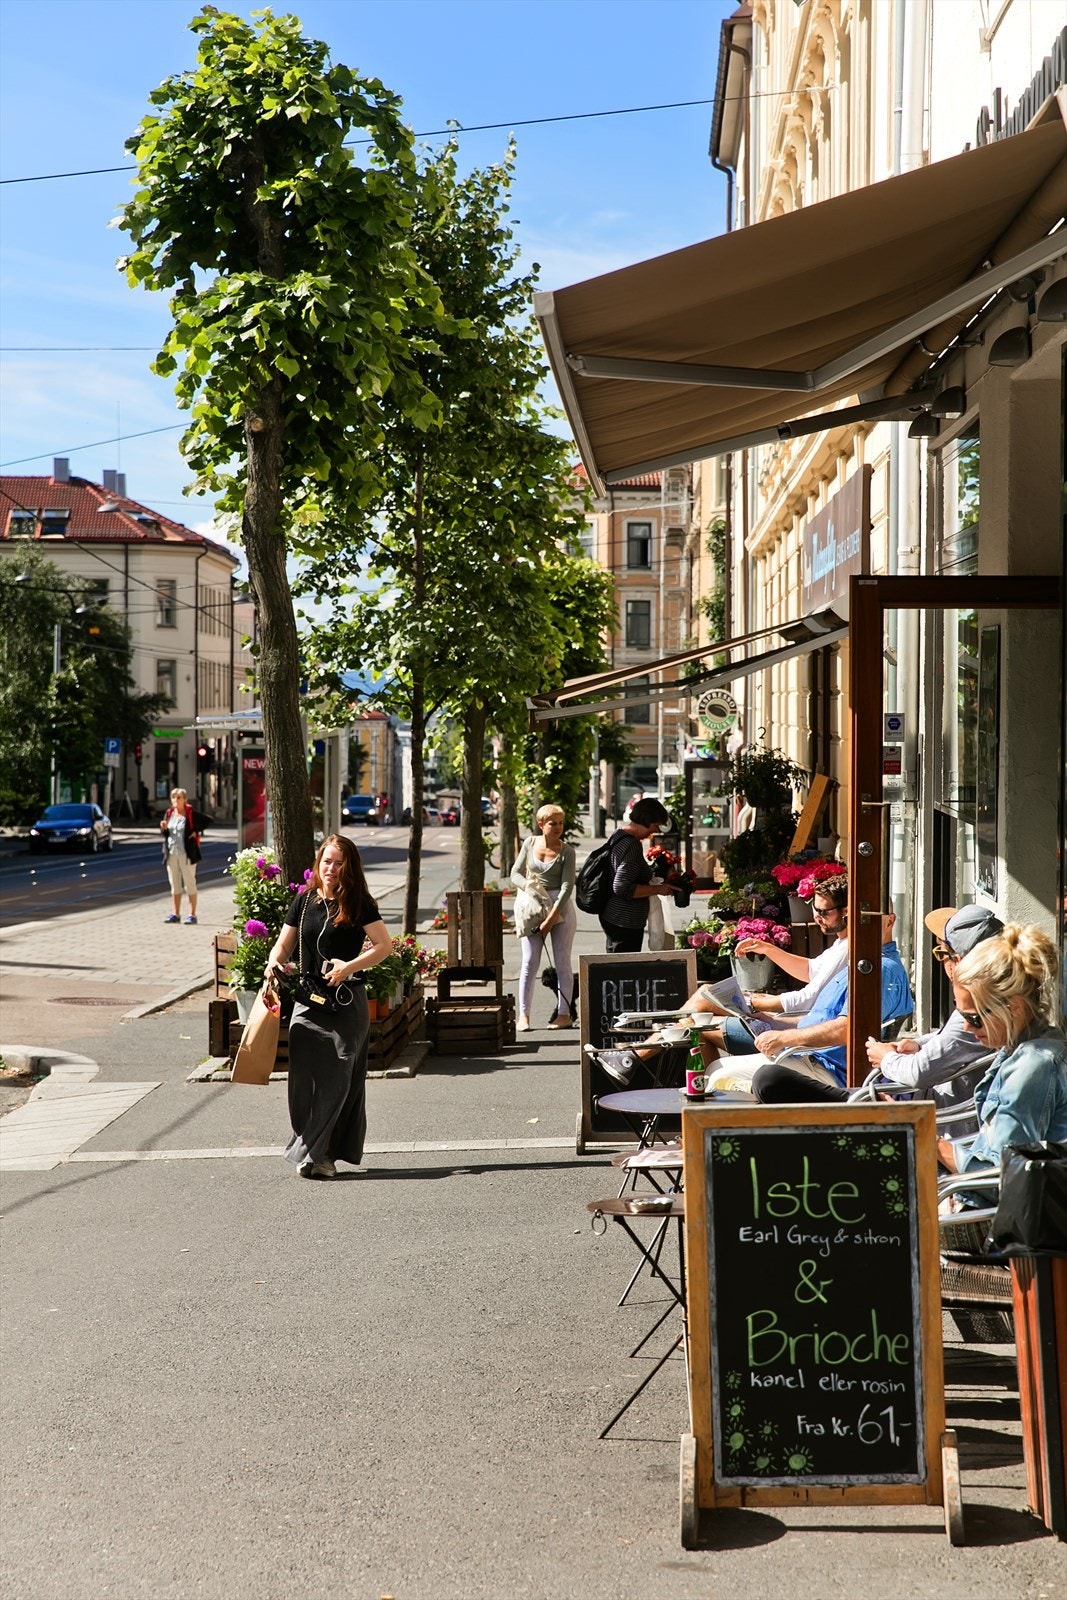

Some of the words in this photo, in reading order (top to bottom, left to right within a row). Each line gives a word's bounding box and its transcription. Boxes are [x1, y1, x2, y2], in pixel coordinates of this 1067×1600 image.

[700, 691, 735, 708] ESPRESSO
[704, 718, 733, 730] HOUSE
[757, 726, 767, 739] 2
[108, 740, 117, 751] P
[750, 1156, 866, 1223] Iste
[739, 1225, 779, 1243] Earl
[787, 1224, 830, 1257] Grey
[833, 1229, 849, 1243] &
[854, 1229, 901, 1246] sitron
[794, 1259, 834, 1304] &
[745, 1308, 910, 1367] Brioche
[750, 1369, 805, 1389] kanel
[818, 1372, 858, 1392] eller
[861, 1379, 906, 1394] rosin
[796, 1414, 825, 1436] Fra
